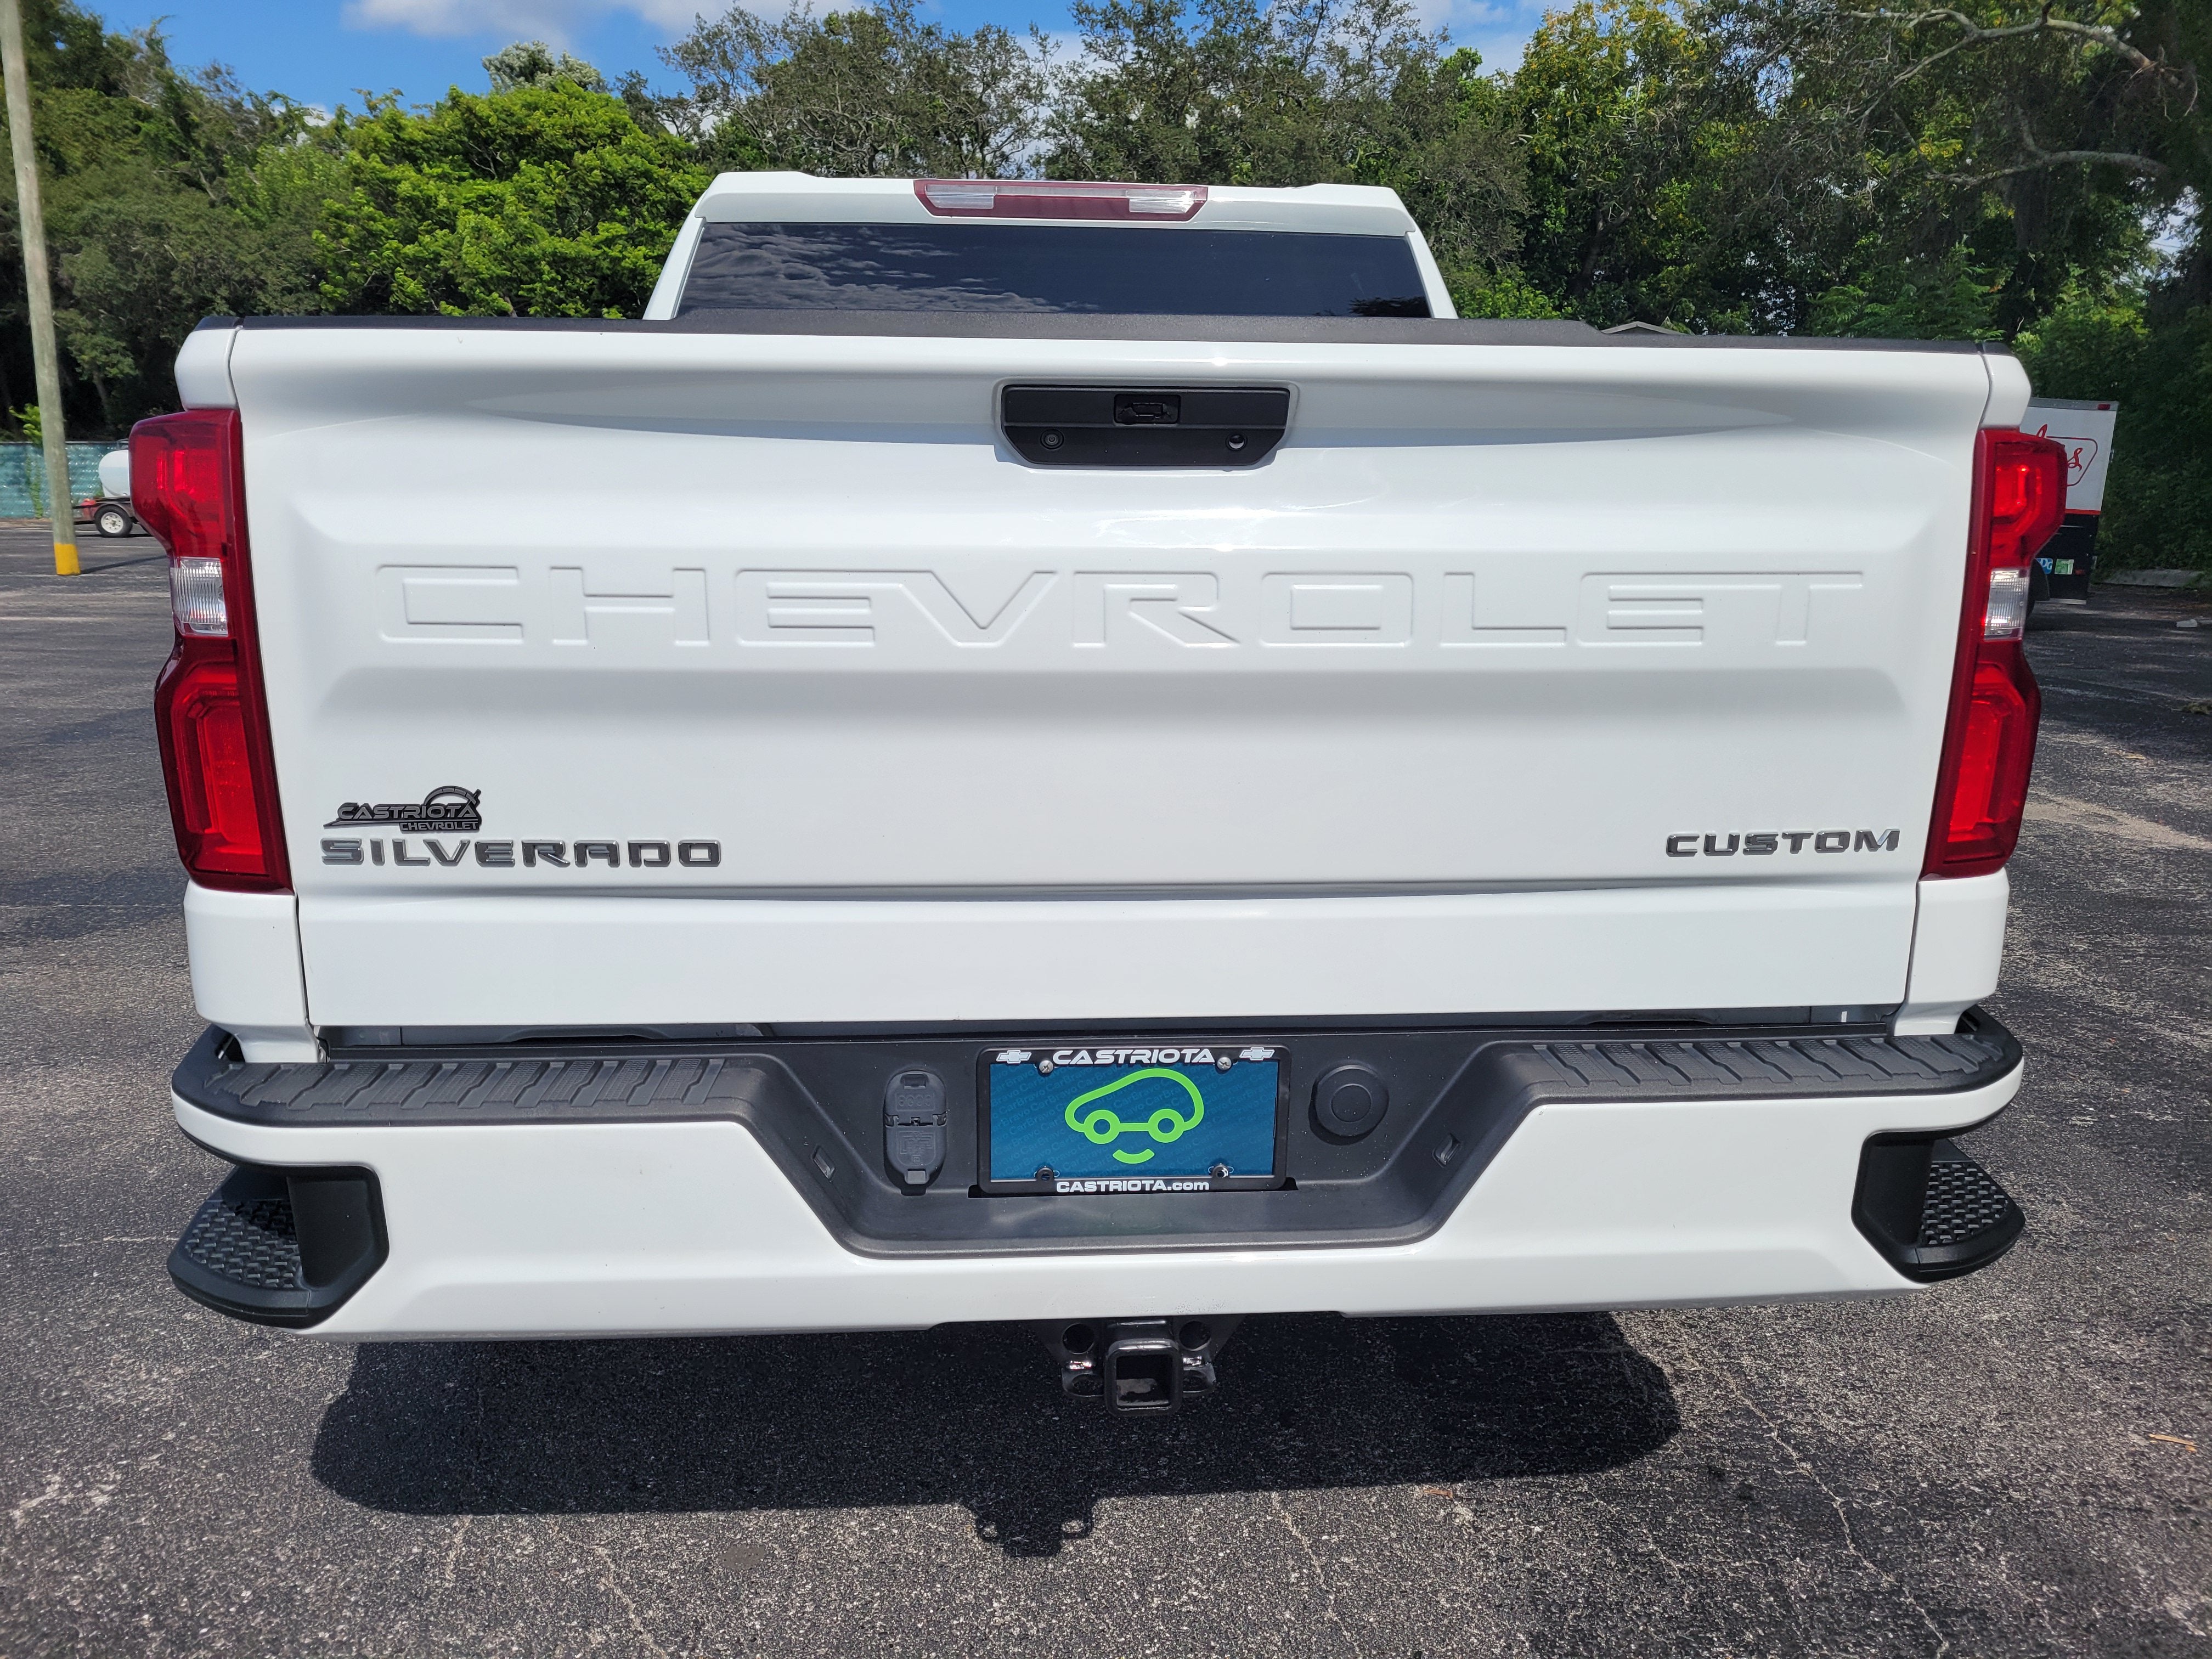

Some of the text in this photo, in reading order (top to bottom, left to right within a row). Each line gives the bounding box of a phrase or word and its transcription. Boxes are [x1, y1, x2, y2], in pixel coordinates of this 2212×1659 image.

[2040, 558, 2052, 570] PG
[376, 566, 1863, 648] CHEVROLET
[338, 805, 477, 819] CASTRIOTA
[401, 822, 478, 831] CHEVROLET
[1666, 829, 1900, 857] CUSTOM
[320, 838, 721, 867] SILVERADO
[1052, 1048, 1215, 1065] CASTRIOTA
[1056, 1180, 1210, 1193] CASTRIOTA.com
